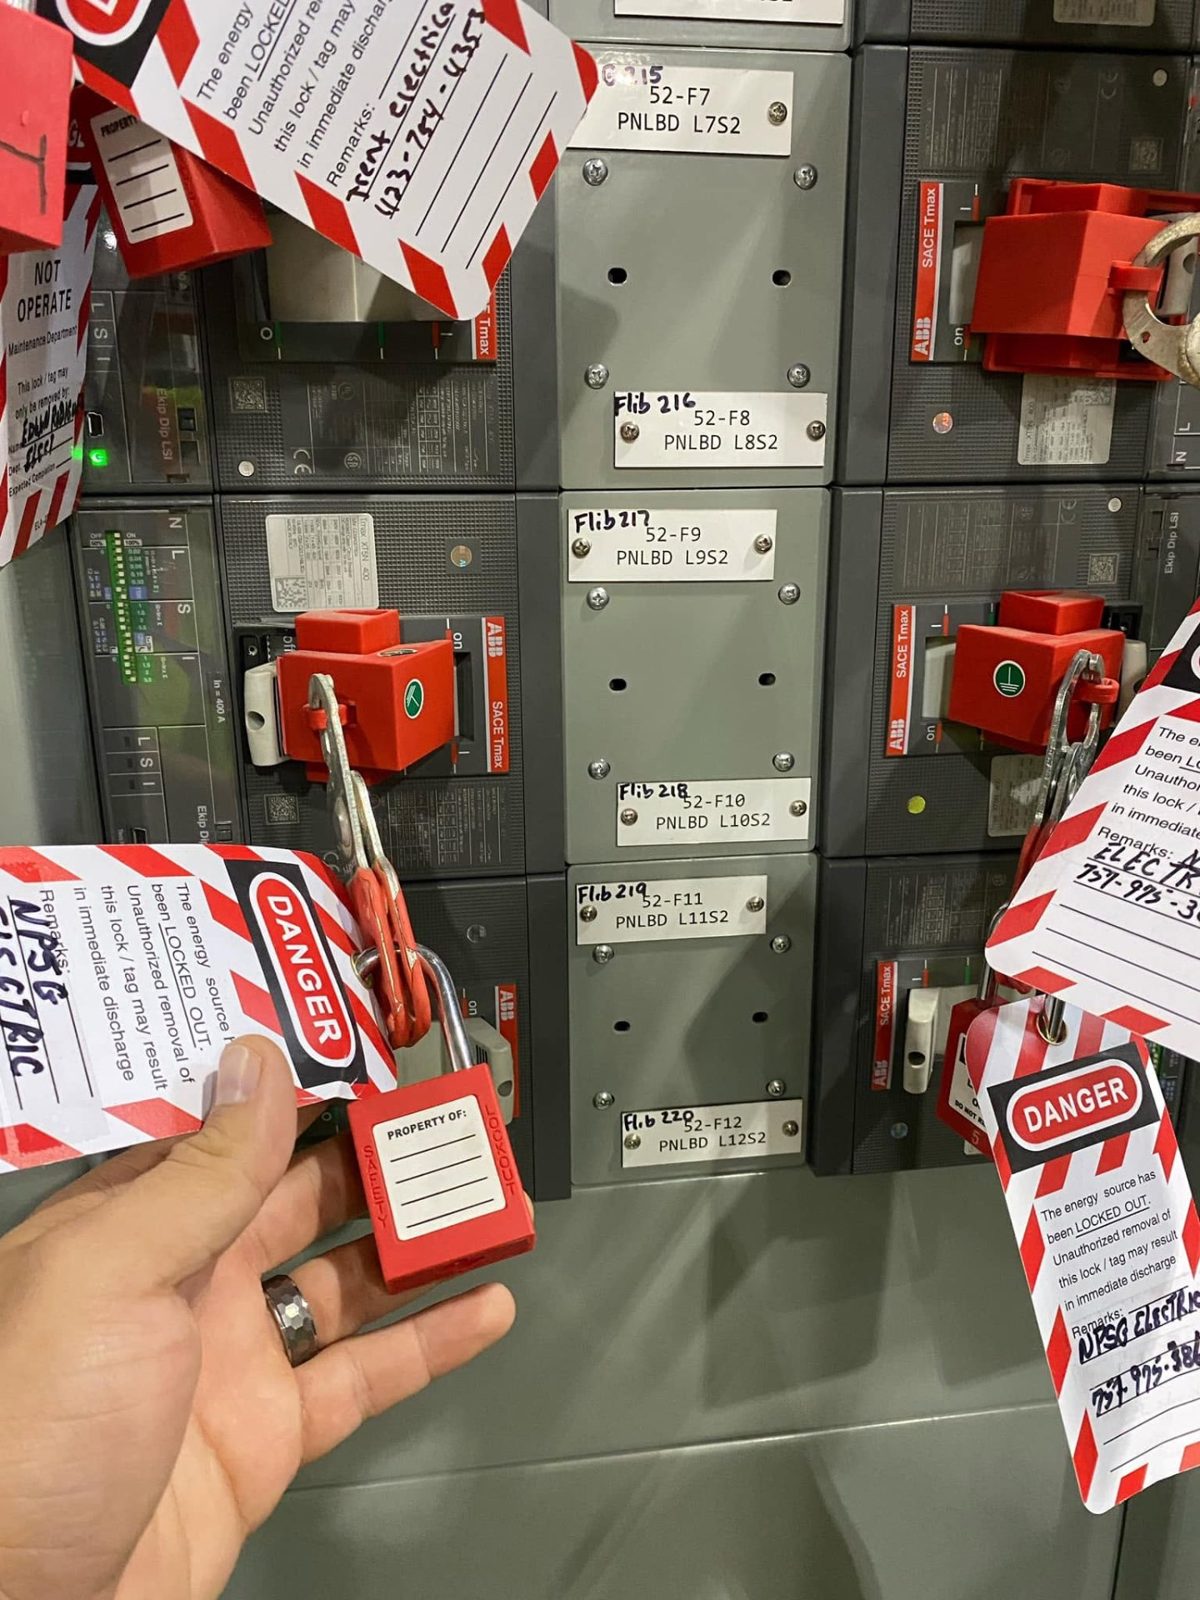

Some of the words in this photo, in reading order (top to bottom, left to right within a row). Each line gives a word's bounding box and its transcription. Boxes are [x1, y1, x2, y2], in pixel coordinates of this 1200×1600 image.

[197, 68, 225, 101] The
[219, 2, 254, 65] energy
[248, 20, 311, 136] Unauthorized
[274, 119, 296, 153] this
[295, 84, 316, 116] lock
[314, 40, 337, 70] tag
[330, 0, 356, 38] may
[223, 71, 253, 120] been
[649, 86, 711, 106] 52-F7
[297, 151, 311, 170] in
[304, 63, 356, 150] immediate
[618, 112, 680, 132] PNLBD
[693, 116, 741, 135] L7S2
[326, 102, 375, 188] Remarks:
[925, 187, 936, 225] Tmax
[922, 226, 934, 269] SACE
[34, 260, 61, 286] NOT
[17, 288, 72, 323] OPERATE
[94, 327, 108, 340] S
[479, 317, 491, 355] Tmax
[914, 316, 931, 355] ABB
[953, 327, 963, 346] on
[17, 381, 31, 396] This
[31, 372, 44, 390] lock
[47, 370, 58, 384] tag
[57, 366, 69, 380] may
[156, 387, 169, 418] Ekip
[613, 391, 651, 416] Flib
[657, 391, 697, 414] 216
[158, 418, 169, 439] Dip
[693, 409, 751, 426] 52-F8
[162, 440, 174, 461] LSI
[664, 434, 722, 450] PNLBD
[734, 434, 778, 450] L8S2
[1175, 451, 1188, 462] N
[168, 517, 183, 529] N
[574, 509, 616, 533] Flib
[620, 509, 650, 528] 217
[645, 527, 701, 542] 52-F9
[1169, 512, 1180, 529] LSI
[1167, 531, 1178, 549] Dip
[171, 550, 185, 560] L
[616, 550, 673, 565] PNLBD
[685, 549, 729, 565] L9S2
[1164, 551, 1176, 574] Ekip
[177, 603, 191, 615] S
[486, 621, 504, 658] ABB
[898, 609, 909, 642] Tmax
[453, 632, 463, 650] on
[896, 646, 908, 679] SACE
[216, 698, 225, 715] 400
[491, 701, 505, 735] SACE
[137, 736, 151, 746] L
[889, 718, 906, 751] ABB
[926, 725, 936, 742] on
[1159, 726, 1186, 743] The
[139, 757, 153, 768] S
[494, 736, 504, 769] Tmax
[1145, 745, 1182, 764] been
[619, 783, 654, 800] Flib
[658, 782, 689, 799] 218
[682, 793, 746, 809] 52-F10
[1123, 783, 1150, 799] this
[1152, 791, 1185, 811] lock
[196, 805, 208, 829] Ekip
[656, 815, 709, 830] PNLBD
[720, 813, 771, 829] L10S2
[1111, 802, 1125, 816] in
[1098, 826, 1174, 860] Remarks:
[74, 887, 86, 901] in
[578, 884, 612, 905] Flib
[616, 882, 647, 900] 219
[642, 892, 704, 909] 52-F11
[39, 888, 71, 974] Remarks:
[616, 914, 668, 929] PNLBD
[679, 910, 729, 926] L11S2
[79, 905, 111, 991] immediate
[177, 882, 193, 911] The
[187, 915, 210, 968] energy
[206, 977, 229, 1031] source
[151, 883, 171, 922] been
[165, 926, 197, 1000] LOCKED
[190, 1006, 212, 1051] OUT.
[267, 895, 342, 1045] DANGER
[883, 966, 891, 994] Tmax
[101, 885, 116, 915] this
[109, 918, 129, 959] lock
[124, 966, 140, 994] tag
[132, 998, 151, 1035] may
[147, 1041, 168, 1091] result
[127, 884, 168, 991] Unauthorized
[158, 993, 189, 1062] removal
[179, 1066, 195, 1084] of
[468, 1000, 478, 1016] on
[500, 990, 515, 1022] ABB
[880, 995, 890, 1027] SACE
[103, 995, 135, 1082] discharge
[872, 1059, 888, 1087] ABB
[1023, 1076, 1129, 1133] DANGER
[387, 1114, 445, 1140] PROPERTY
[448, 1109, 467, 1122] OF:
[684, 1116, 743, 1133] 52-F12
[484, 1104, 516, 1196] LOCKOUT
[659, 1136, 709, 1153] PNLBD
[719, 1132, 767, 1148] L12S2
[363, 1144, 388, 1229] SAFETY
[1040, 1208, 1063, 1222] The
[1064, 1192, 1099, 1213] energy
[1103, 1179, 1137, 1198] source
[1137, 1170, 1157, 1185] has
[1046, 1225, 1074, 1245] been
[1075, 1205, 1122, 1234] LOCKED
[1124, 1194, 1152, 1213] OUT.
[1052, 1229, 1121, 1267] Unauthorized
[1121, 1216, 1161, 1242] removal
[1162, 1209, 1172, 1221] of
[1058, 1275, 1079, 1290] this
[1079, 1262, 1102, 1281] lock
[1109, 1252, 1127, 1271] tag
[1127, 1243, 1149, 1260] may
[1151, 1229, 1179, 1250] result
[1064, 1299, 1076, 1312] in
[1076, 1276, 1129, 1306] immediate
[1130, 1255, 1177, 1283] discharge
[1071, 1308, 1124, 1340] Remarks:
